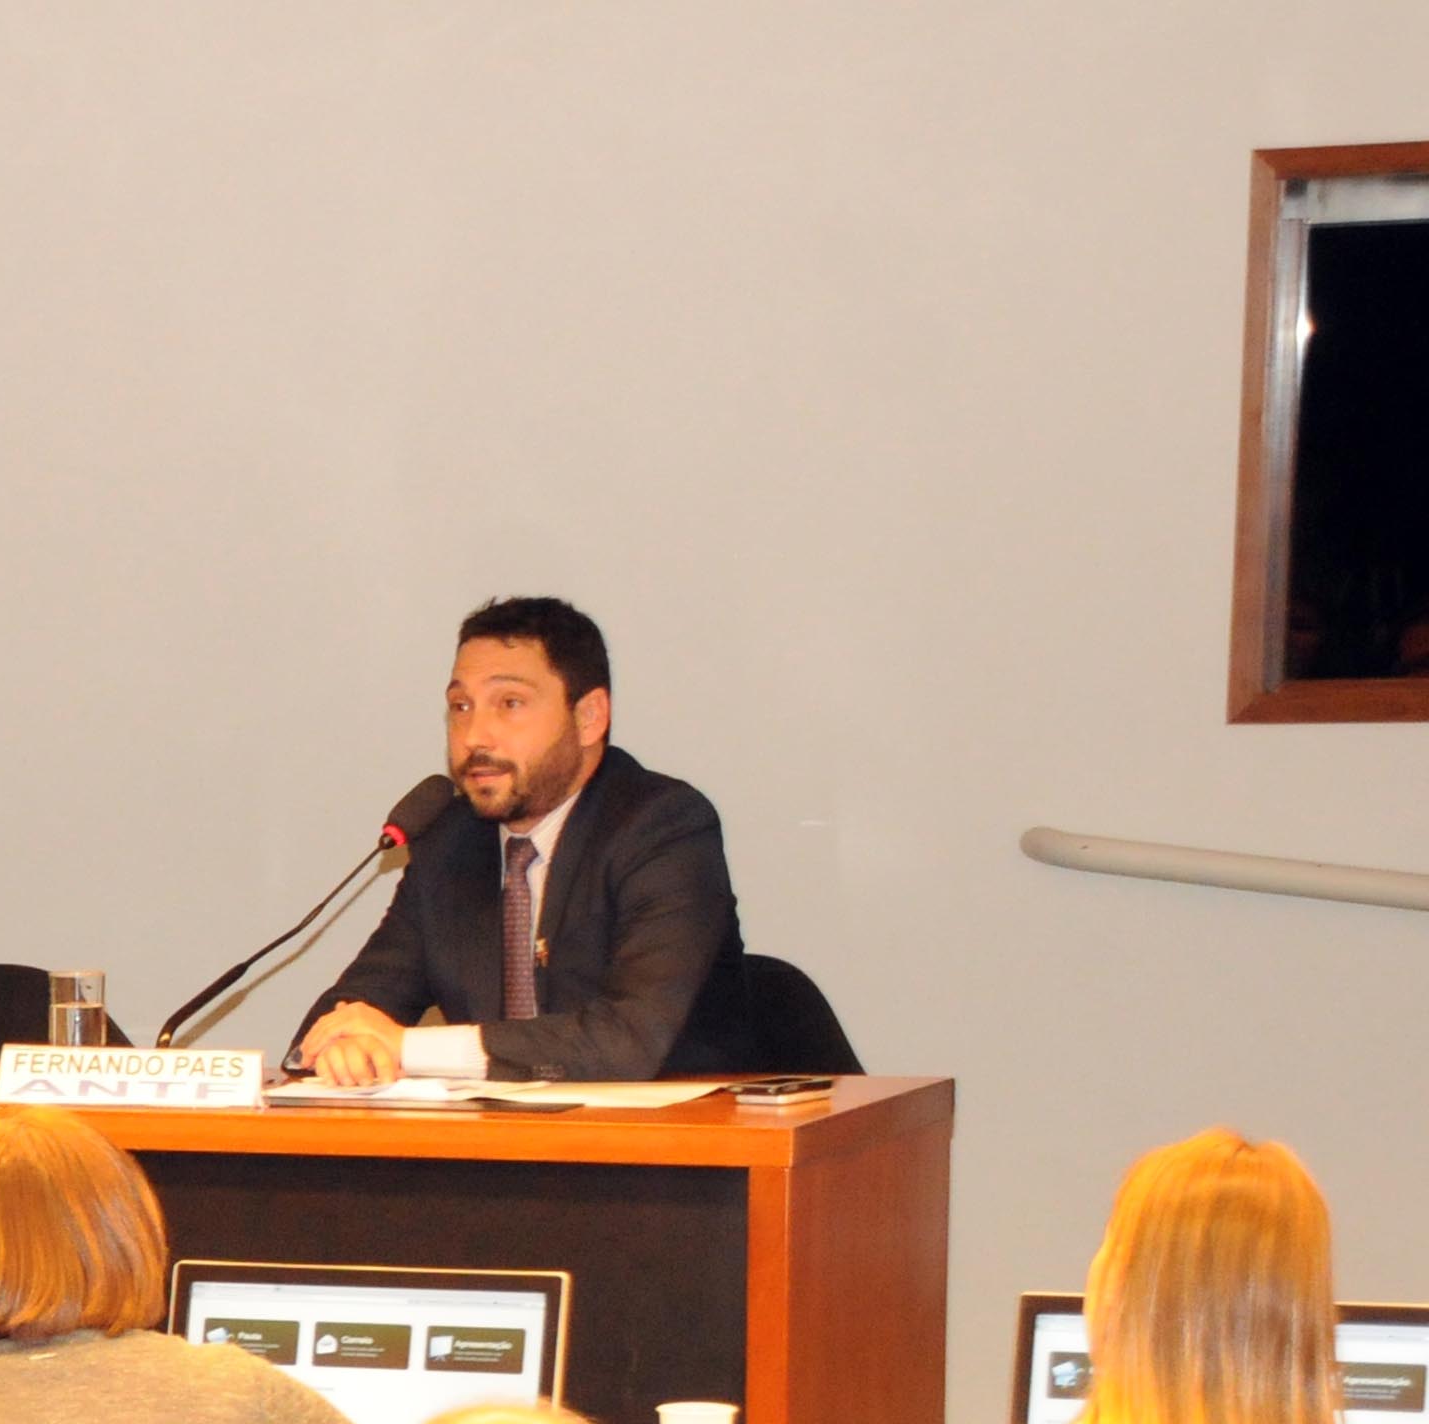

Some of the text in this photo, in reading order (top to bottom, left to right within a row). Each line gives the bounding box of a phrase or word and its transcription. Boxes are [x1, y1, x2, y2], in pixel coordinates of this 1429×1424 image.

[13, 1052, 244, 1078] FERNANDO PAES
[10, 1078, 241, 1100] ANTF
